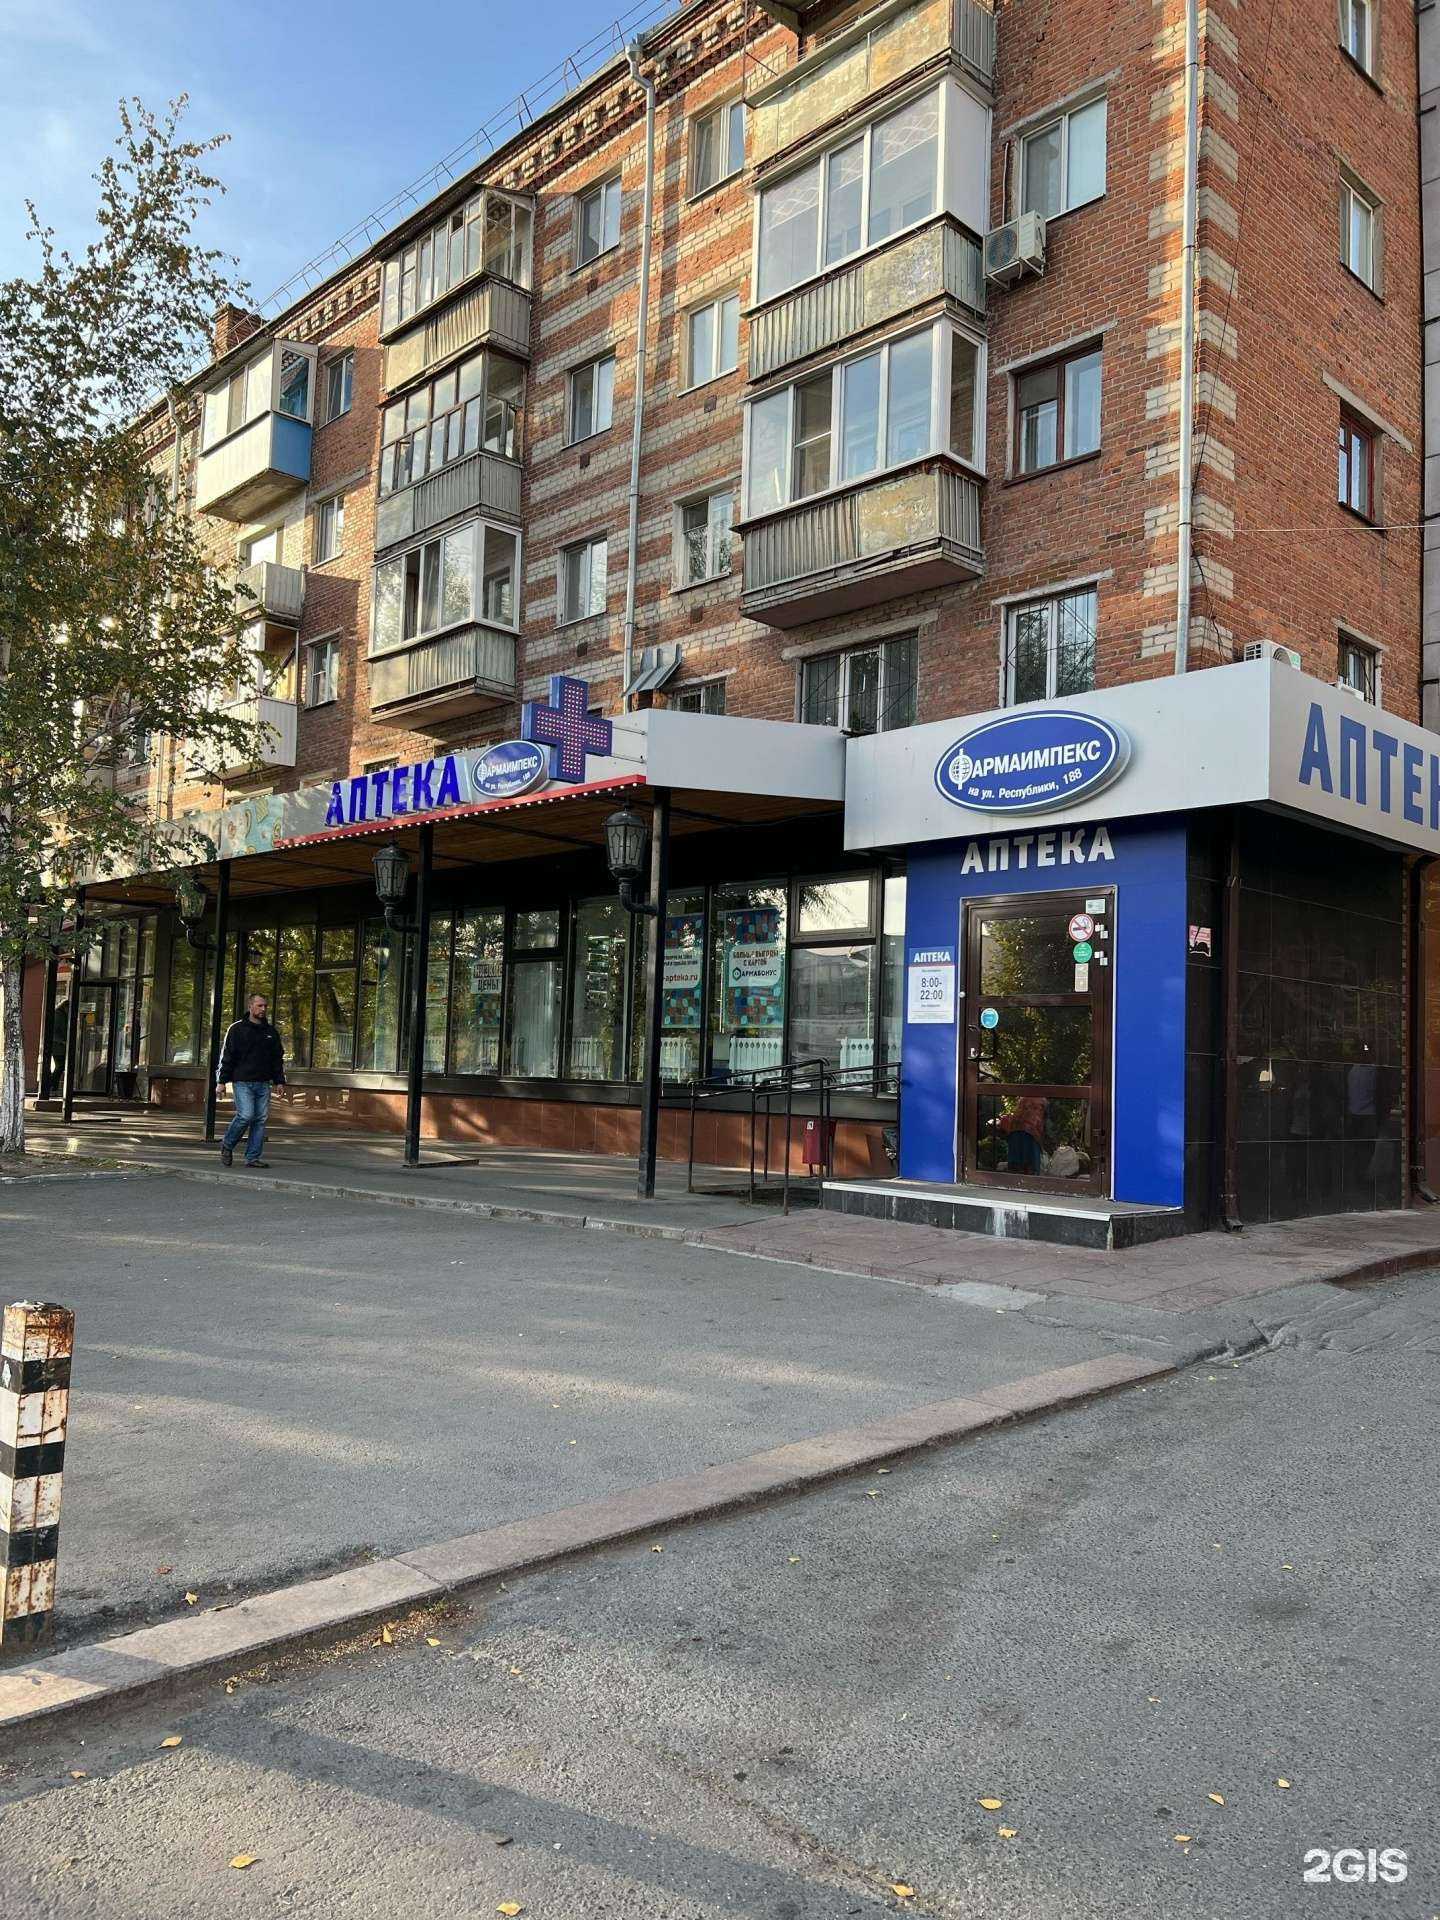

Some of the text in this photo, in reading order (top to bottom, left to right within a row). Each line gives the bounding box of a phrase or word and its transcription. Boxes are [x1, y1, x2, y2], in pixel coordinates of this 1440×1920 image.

[325, 755, 461, 825] АПТЕКА
[968, 768, 1083, 800] на ул. Республики, 188
[960, 826, 1115, 875] АПТЕКА
[913, 951, 951, 962] АПТЕКА
[920, 989, 943, 1000] 22:00
